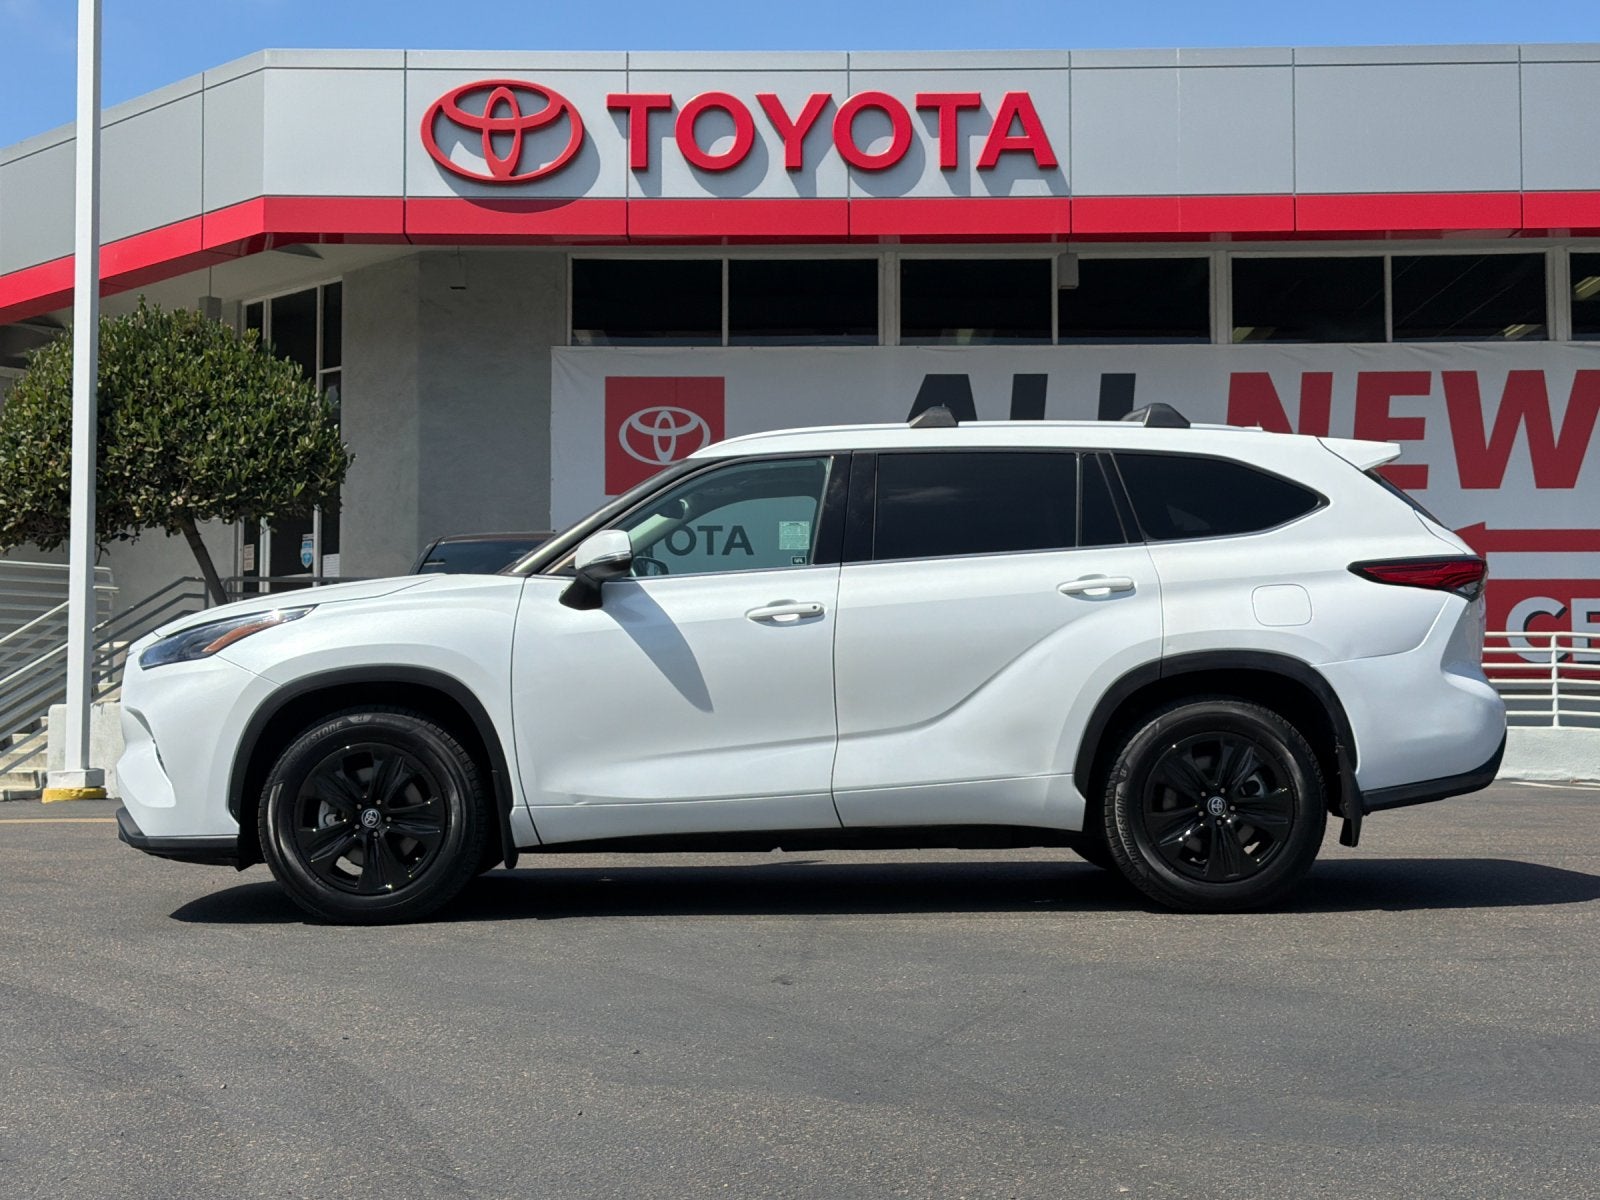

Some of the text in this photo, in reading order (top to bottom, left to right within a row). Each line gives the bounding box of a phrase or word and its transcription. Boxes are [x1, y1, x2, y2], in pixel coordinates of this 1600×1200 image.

[606, 91, 1058, 171] TOYOTA
[1226, 370, 1600, 489] NEW
[646, 524, 755, 557] OTA
[284, 720, 343, 768] IDGESTONE
